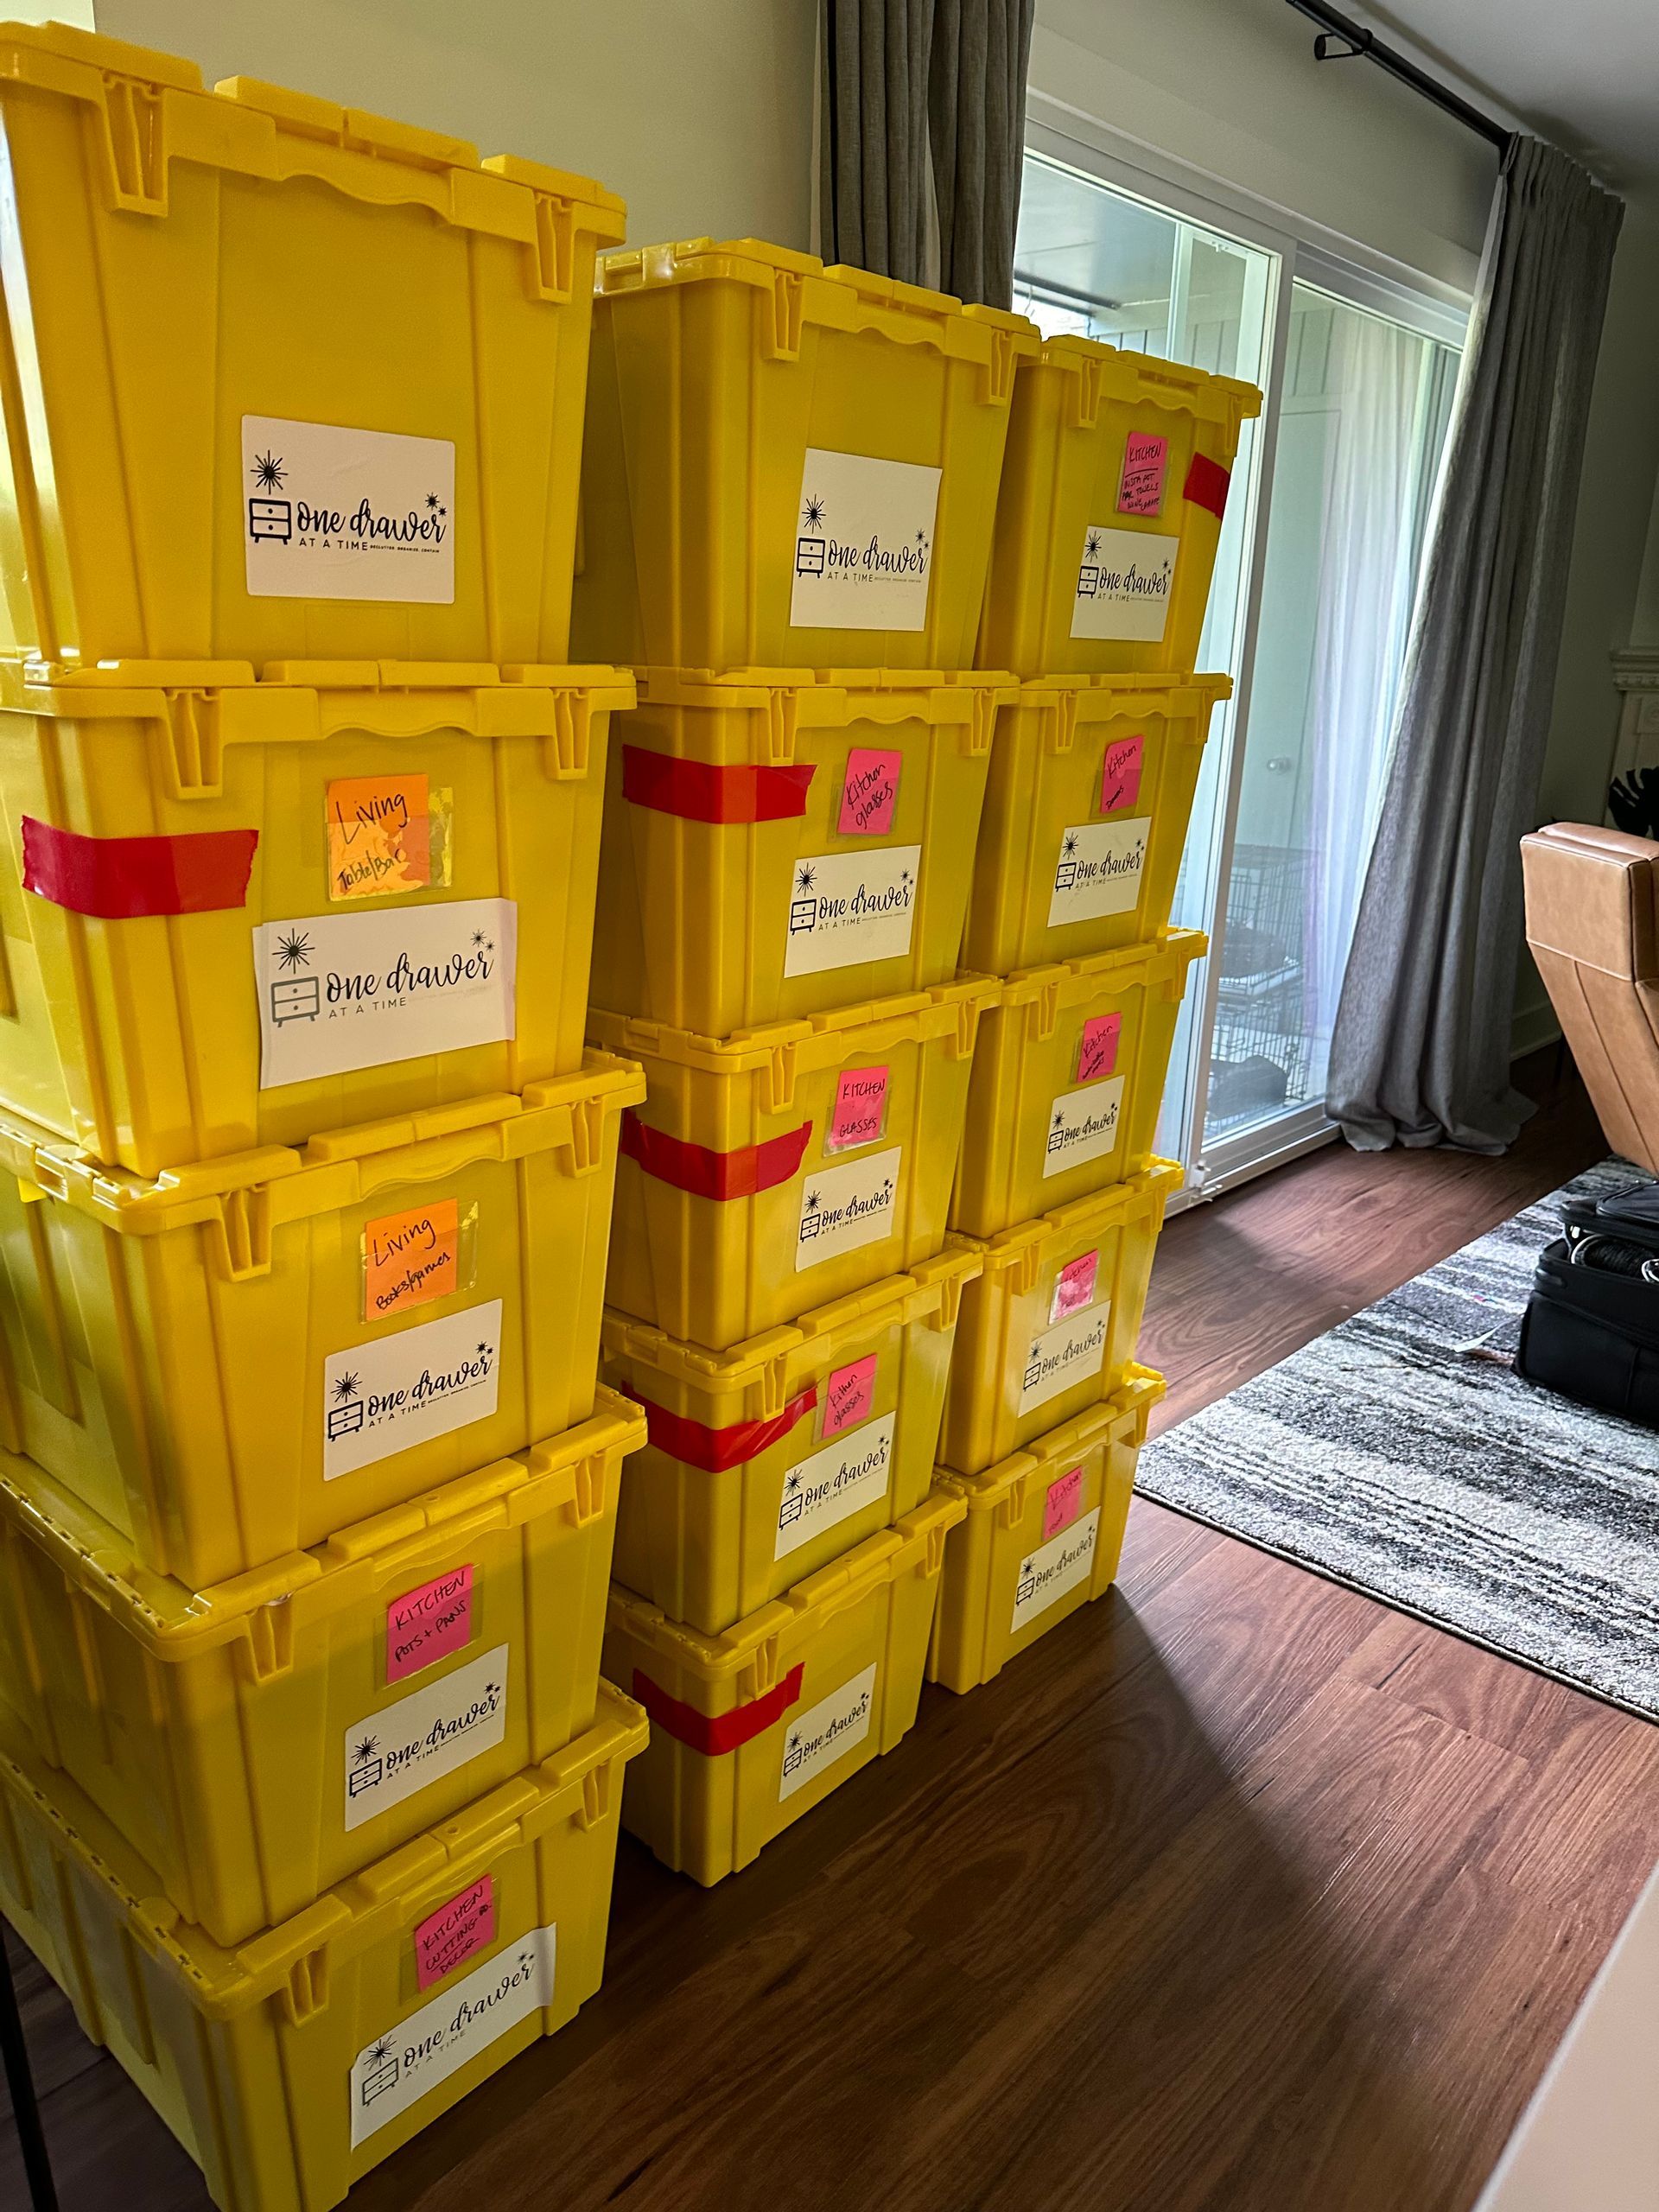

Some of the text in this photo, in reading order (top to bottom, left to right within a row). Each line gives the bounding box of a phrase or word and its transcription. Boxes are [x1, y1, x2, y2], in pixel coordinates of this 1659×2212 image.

[1128, 442, 1162, 464] KITCHEN
[297, 498, 447, 543] one drawer
[299, 537, 315, 547] AT
[322, 539, 331, 548] A
[338, 540, 368, 551] TIME
[828, 535, 929, 574] one drawer
[827, 571, 839, 580] AT
[842, 572, 849, 581] A
[853, 573, 874, 582] TIME
[1099, 563, 1169, 595] one drawer
[1107, 745, 1137, 779] Kitchen
[335, 792, 409, 845] Living
[1077, 849, 1142, 880] one drawer
[819, 896, 850, 919] one
[850, 883, 913, 914] drawer
[817, 917, 861, 931] AT A TIME
[327, 971, 383, 1003] one
[387, 950, 495, 994] drawer
[328, 996, 408, 1020] AT A TIME
[842, 1078, 887, 1100] KITCHEN
[839, 1116, 879, 1139] GLASSES
[1064, 1126, 1081, 1142] one
[1082, 1112, 1117, 1136] drawer
[822, 1206, 846, 1228] one
[845, 1188, 893, 1219] drawer
[372, 1217, 437, 1268] Living
[821, 1226, 831, 1236] AT
[837, 1218, 854, 1230] TIME
[1041, 1357, 1060, 1375] one
[1062, 1331, 1103, 1361] drawer
[367, 1389, 411, 1418] one
[410, 1354, 493, 1402] drawer
[368, 1399, 427, 1428] AT A TIME
[804, 1479, 832, 1507] one
[833, 1445, 889, 1489] drawer
[804, 1505, 814, 1516] AT
[825, 1490, 843, 1503] TIME
[1035, 1565, 1055, 1587] one
[1055, 1533, 1093, 1570] drawer
[395, 1570, 467, 1631] KITCHEN
[394, 1635, 424, 1662] POTS
[423, 1627, 434, 1639] +
[385, 1739, 426, 1770] one
[425, 1694, 500, 1746] drawer
[803, 1733, 824, 1757] one
[824, 1699, 868, 1739] drawer
[386, 1767, 400, 1780] AT
[416, 1745, 440, 1763] TIME
[422, 1885, 484, 1951] KITCHEN
[425, 1917, 478, 1971] CUTTING
[404, 1962, 536, 2069] one drawer
[404, 2029, 467, 2079] AT A TIME
